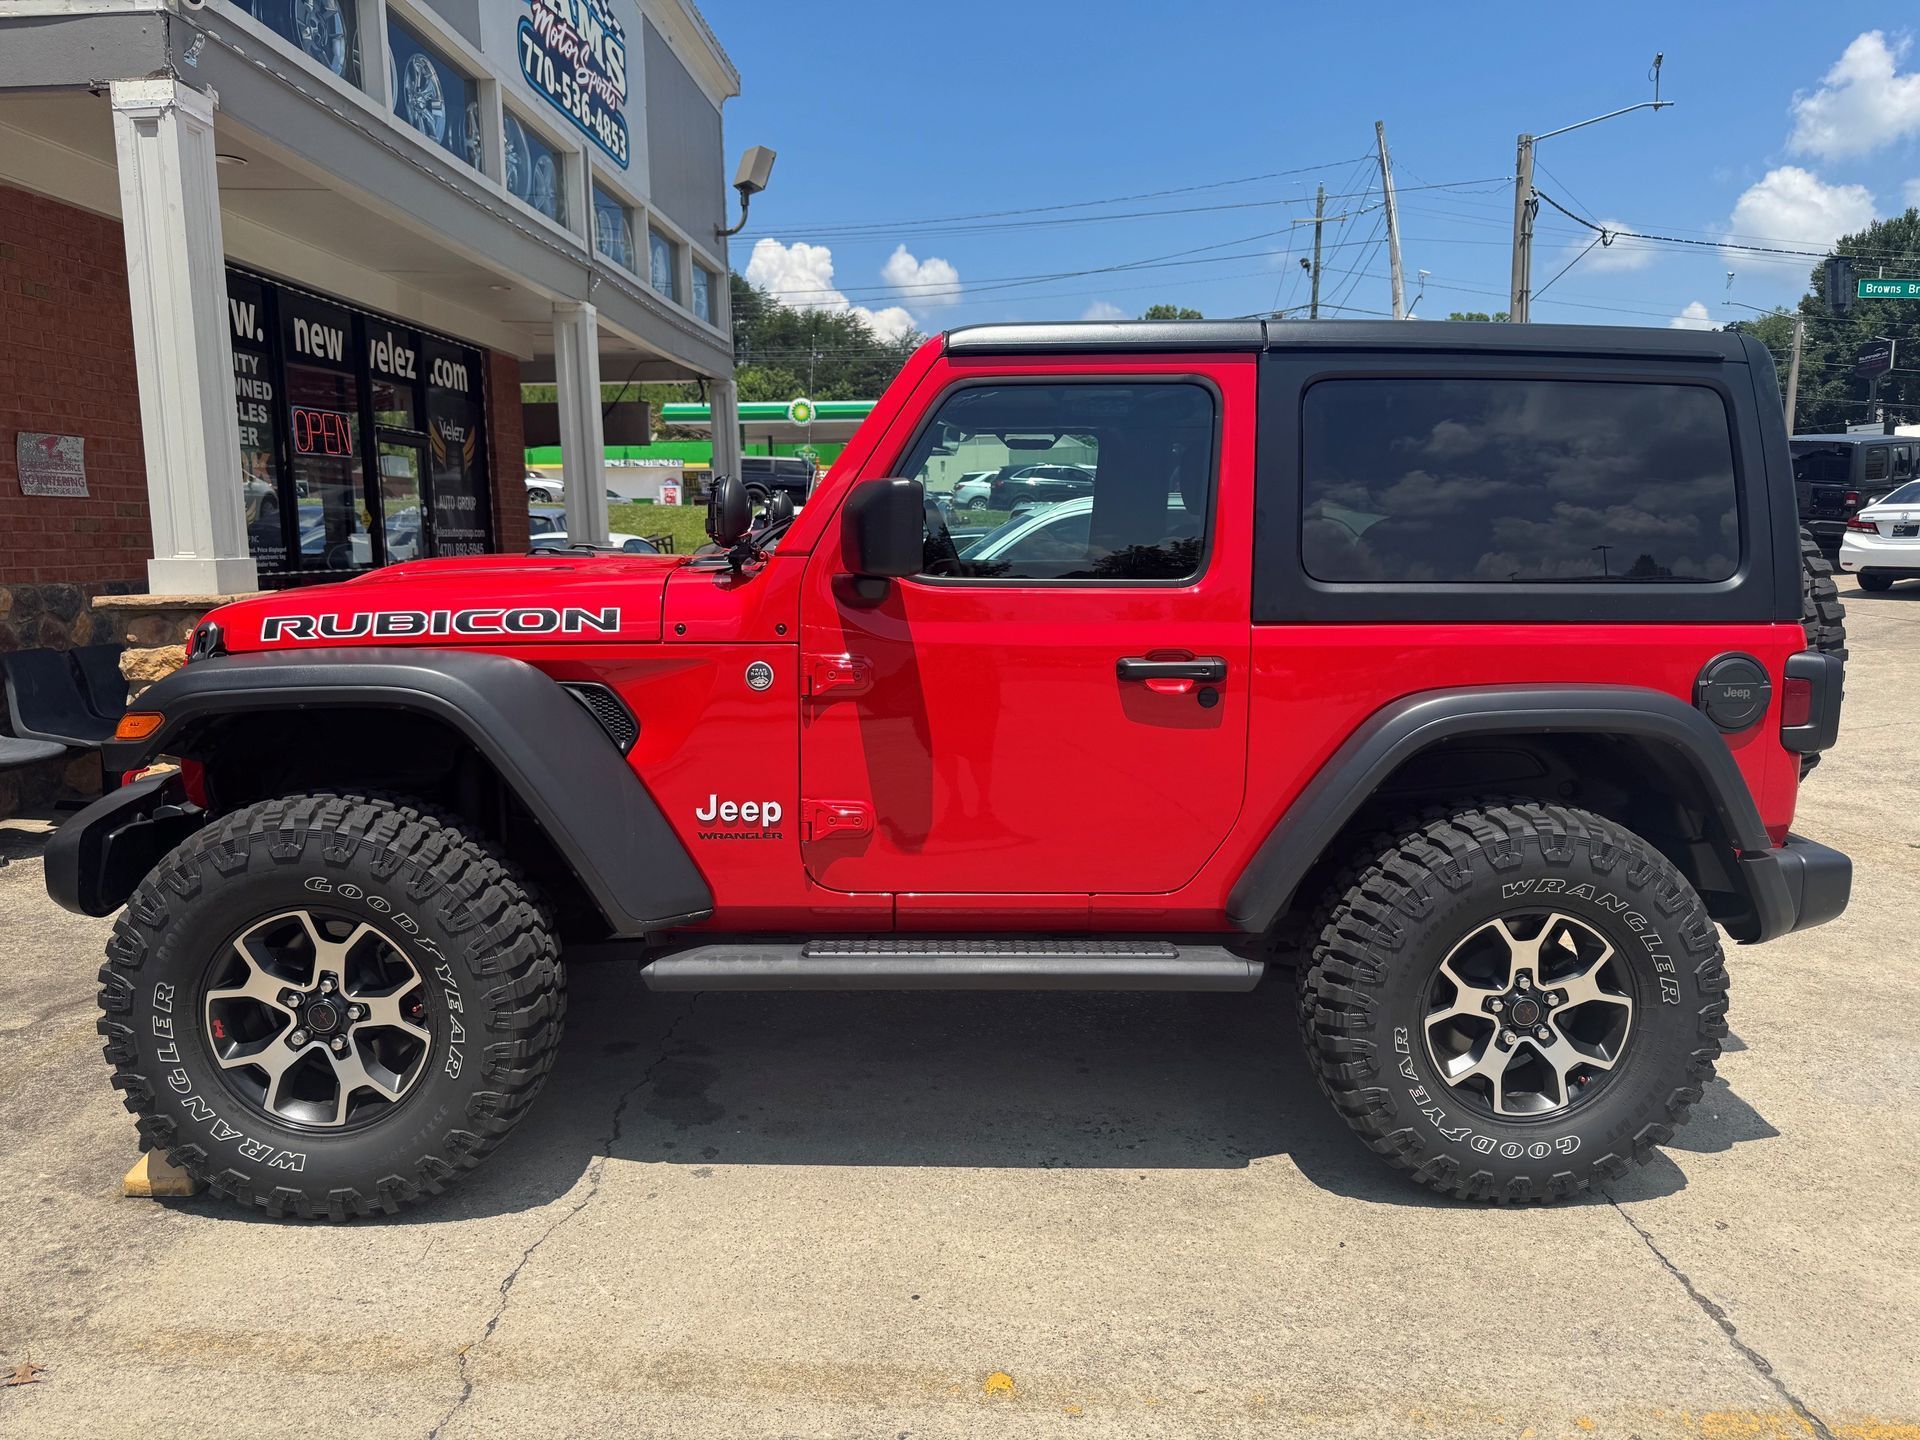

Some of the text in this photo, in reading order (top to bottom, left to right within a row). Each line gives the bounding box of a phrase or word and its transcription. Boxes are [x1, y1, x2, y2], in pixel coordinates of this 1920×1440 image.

[522, 32, 627, 162] 770-536-4853
[1866, 283, 1902, 294] Browns
[233, 351, 259, 375] ITY
[293, 317, 343, 362] new
[430, 358, 468, 392] .com
[239, 425, 260, 447] ER
[294, 409, 353, 454] OPEN
[438, 418, 466, 443] Velez
[439, 495, 477, 511] AUTO GROUP
[260, 607, 621, 642] RUBICON
[1723, 687, 1750, 699] Jeep
[695, 794, 782, 827] Jeep
[697, 832, 783, 840] WRANGLER
[1502, 878, 1680, 1005] WRANGLER
[304, 876, 465, 1080] GOODYEAR
[152, 982, 307, 1172] WRANGLER
[1393, 1026, 1581, 1159] GOODYEAR
